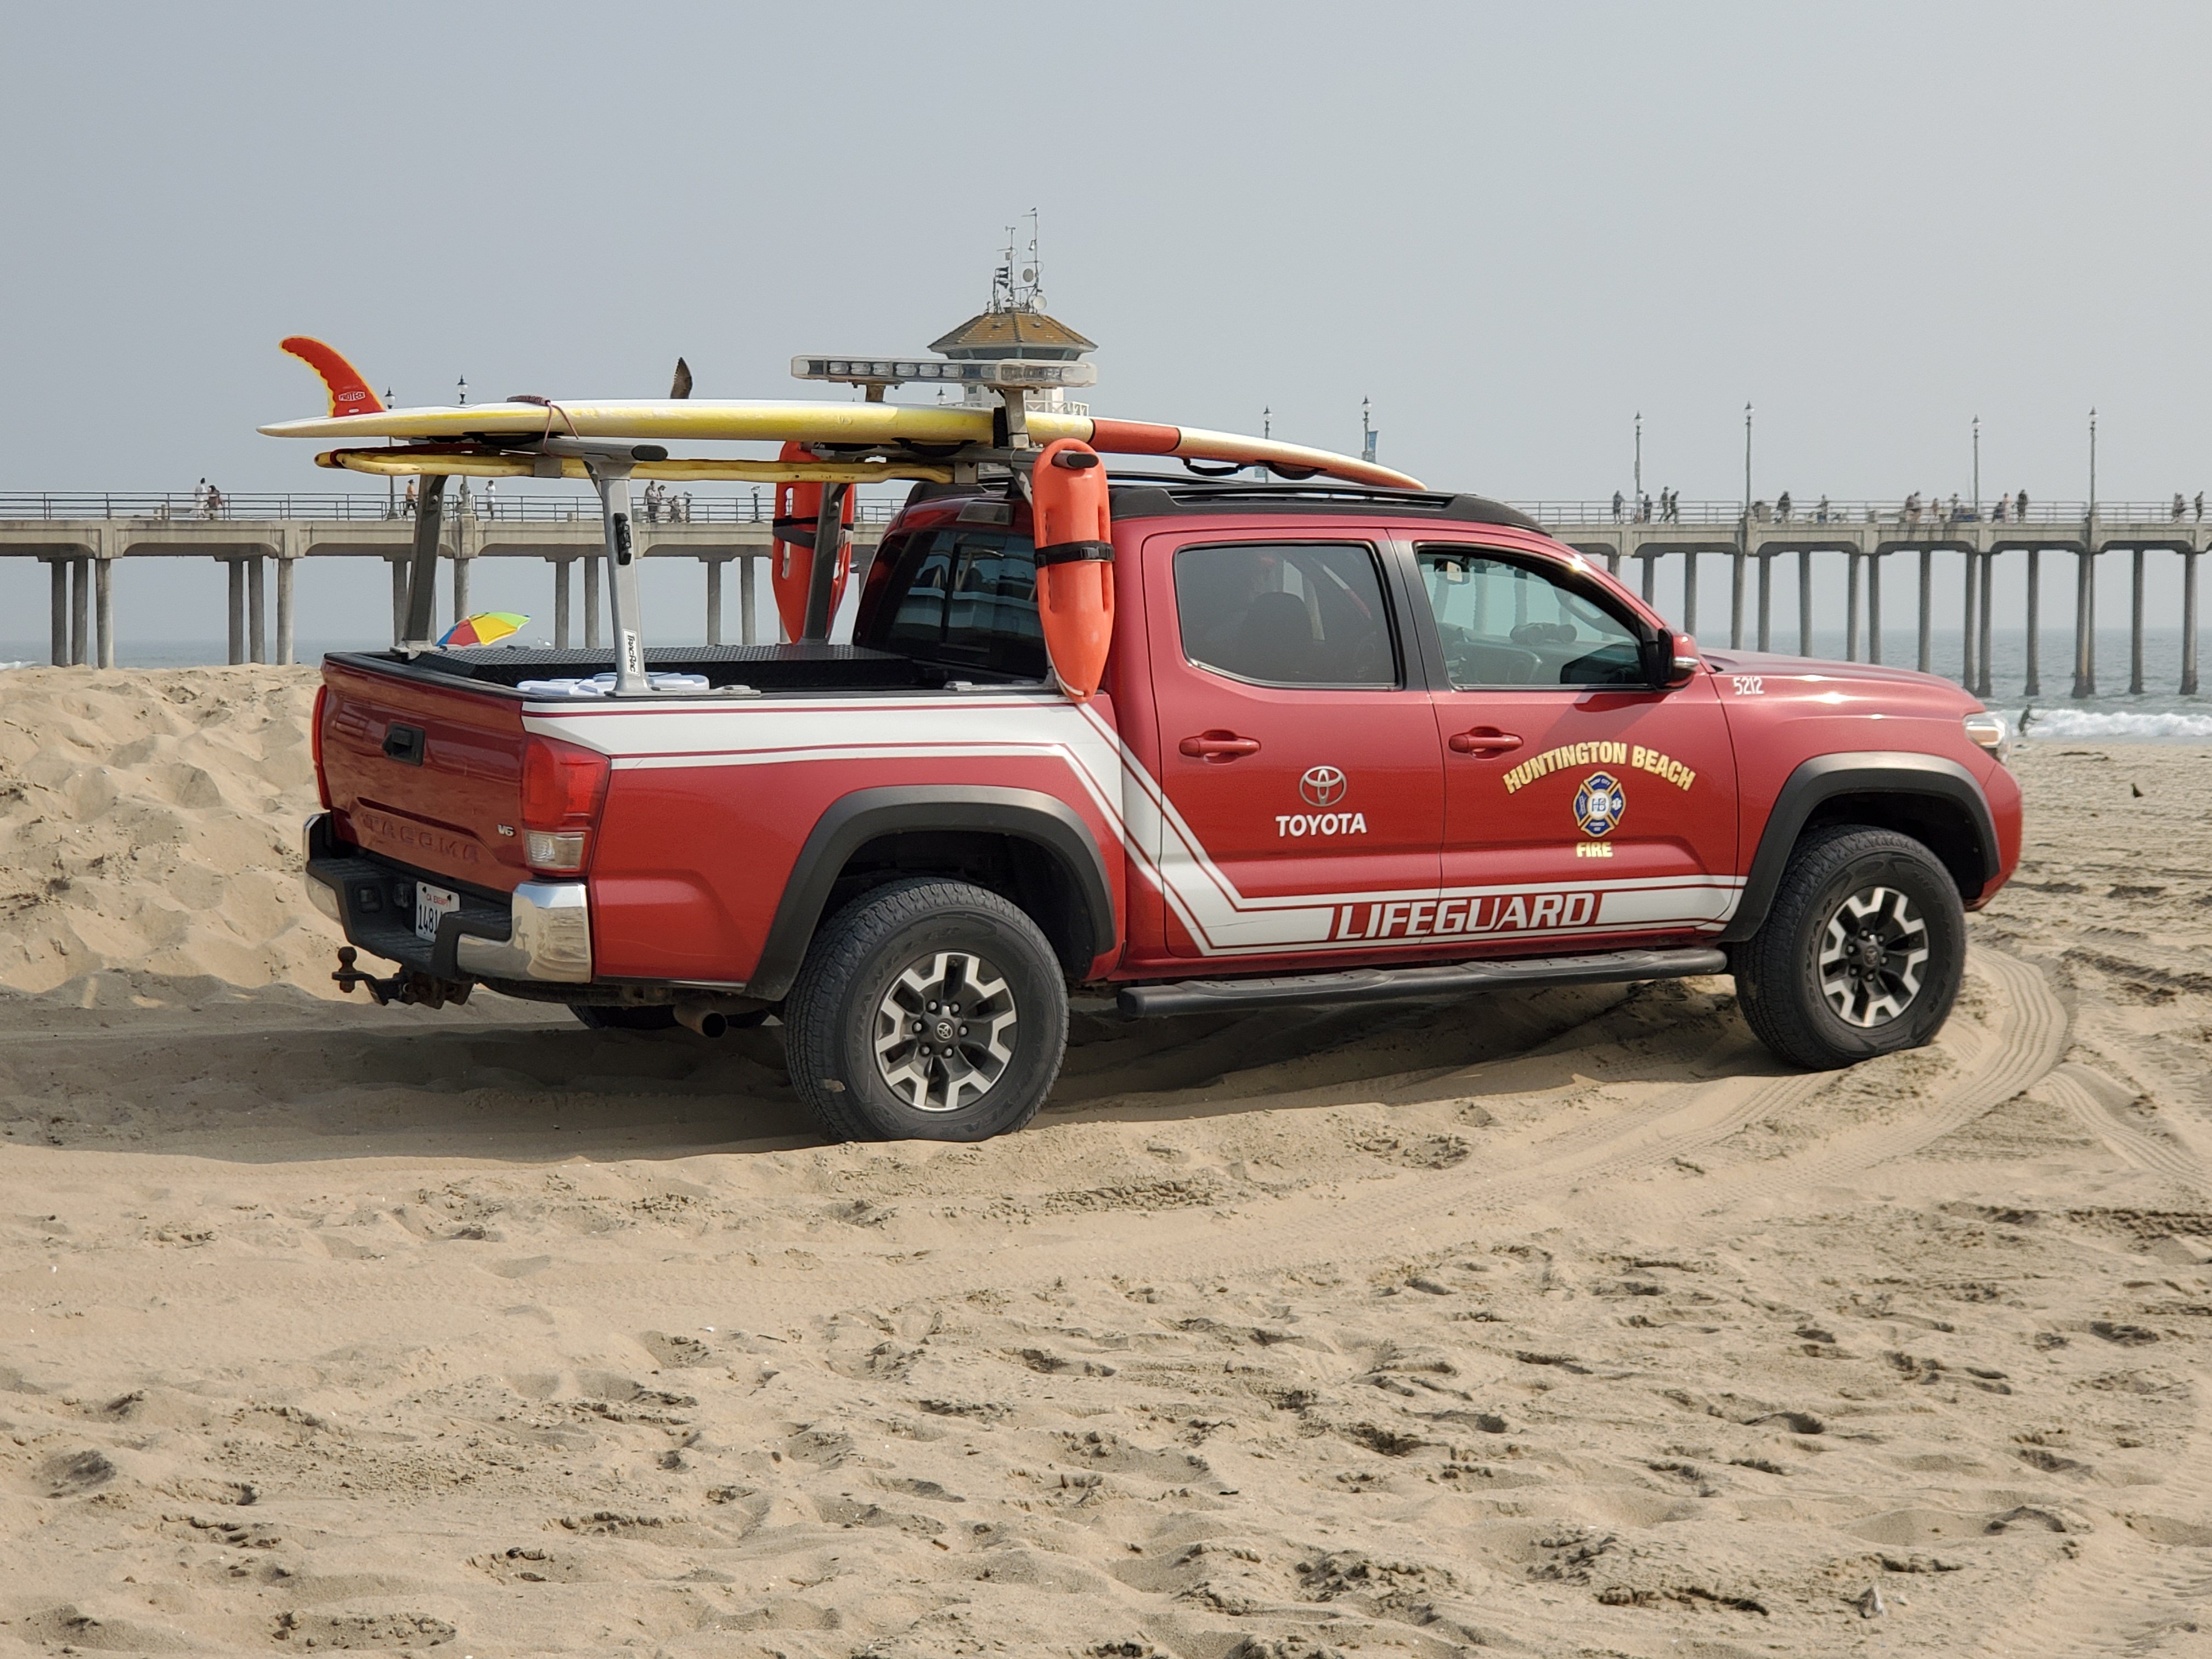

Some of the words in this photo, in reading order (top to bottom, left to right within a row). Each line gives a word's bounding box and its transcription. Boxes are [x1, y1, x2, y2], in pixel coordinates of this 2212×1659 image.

[1733, 676, 1765, 695] 5212
[1502, 741, 1627, 794] HUNTINGTON
[1631, 745, 1697, 792] BEACH
[498, 825, 514, 837] V6
[1276, 812, 1368, 837] TOYOTA
[1576, 841, 1613, 857] FIRE
[418, 904, 443, 935] 1481
[1335, 893, 1595, 940] LIFEGUARD
